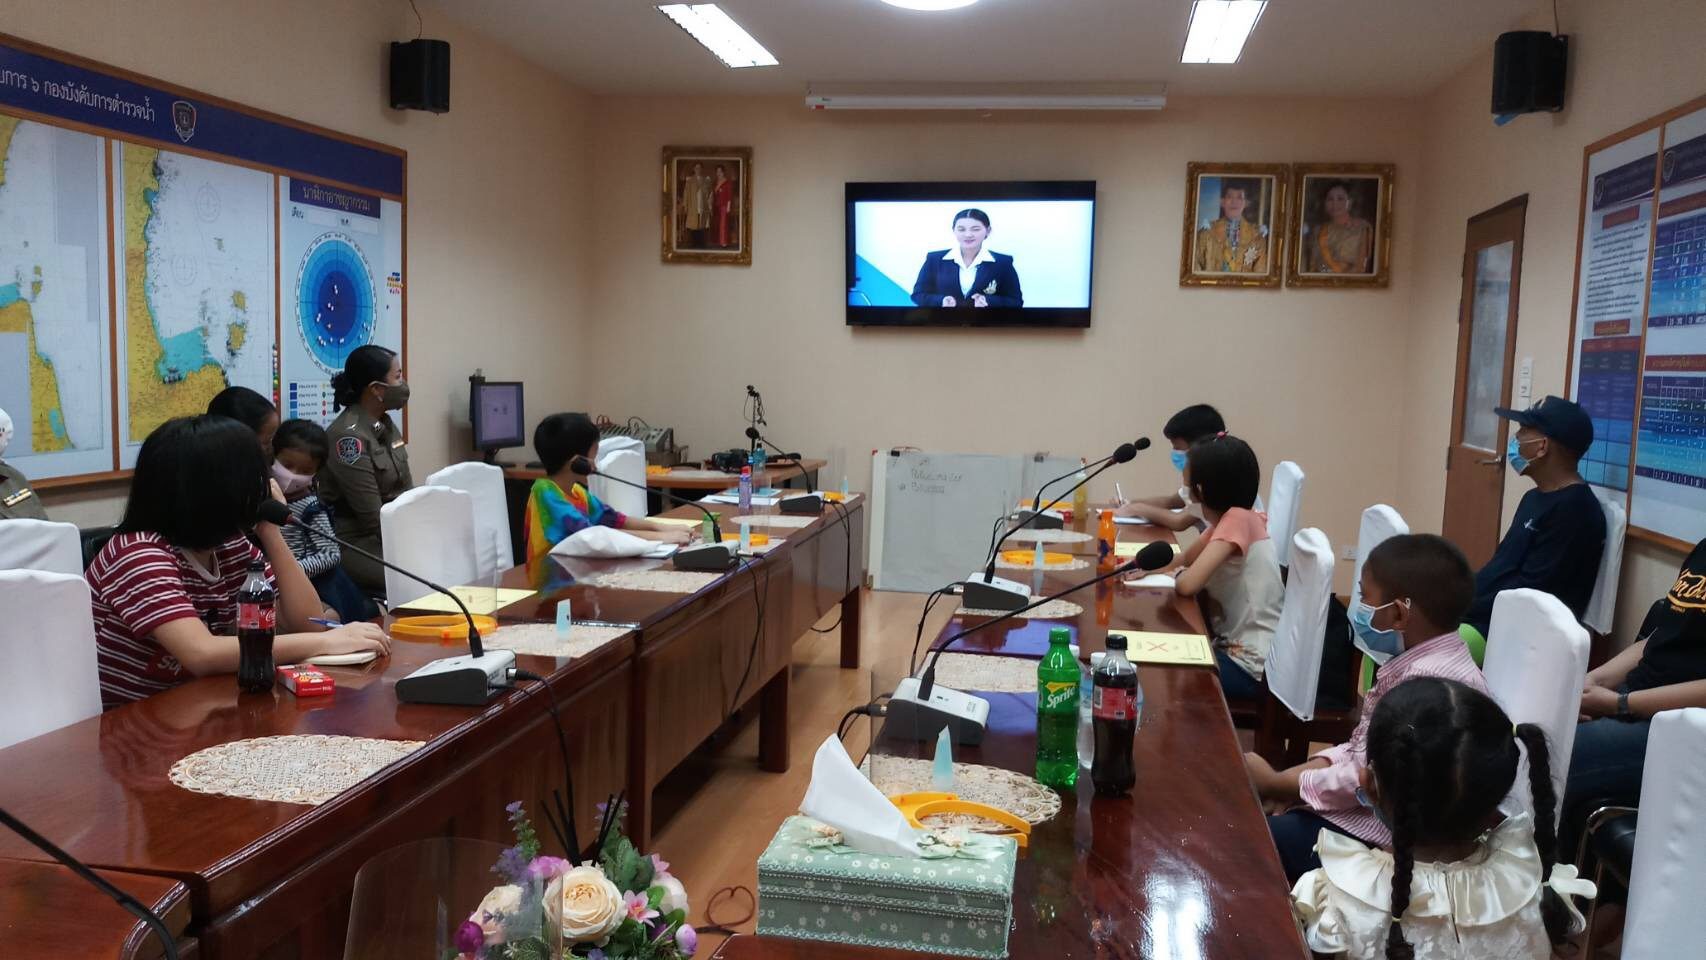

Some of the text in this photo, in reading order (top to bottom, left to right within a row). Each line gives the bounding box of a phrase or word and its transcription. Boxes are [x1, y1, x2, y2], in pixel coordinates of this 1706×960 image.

[31, 77, 40, 92] ๖
[44, 80, 156, 123] กองบังคับการตำรวจน้ำ
[1046, 686, 1076, 709] Sprite
